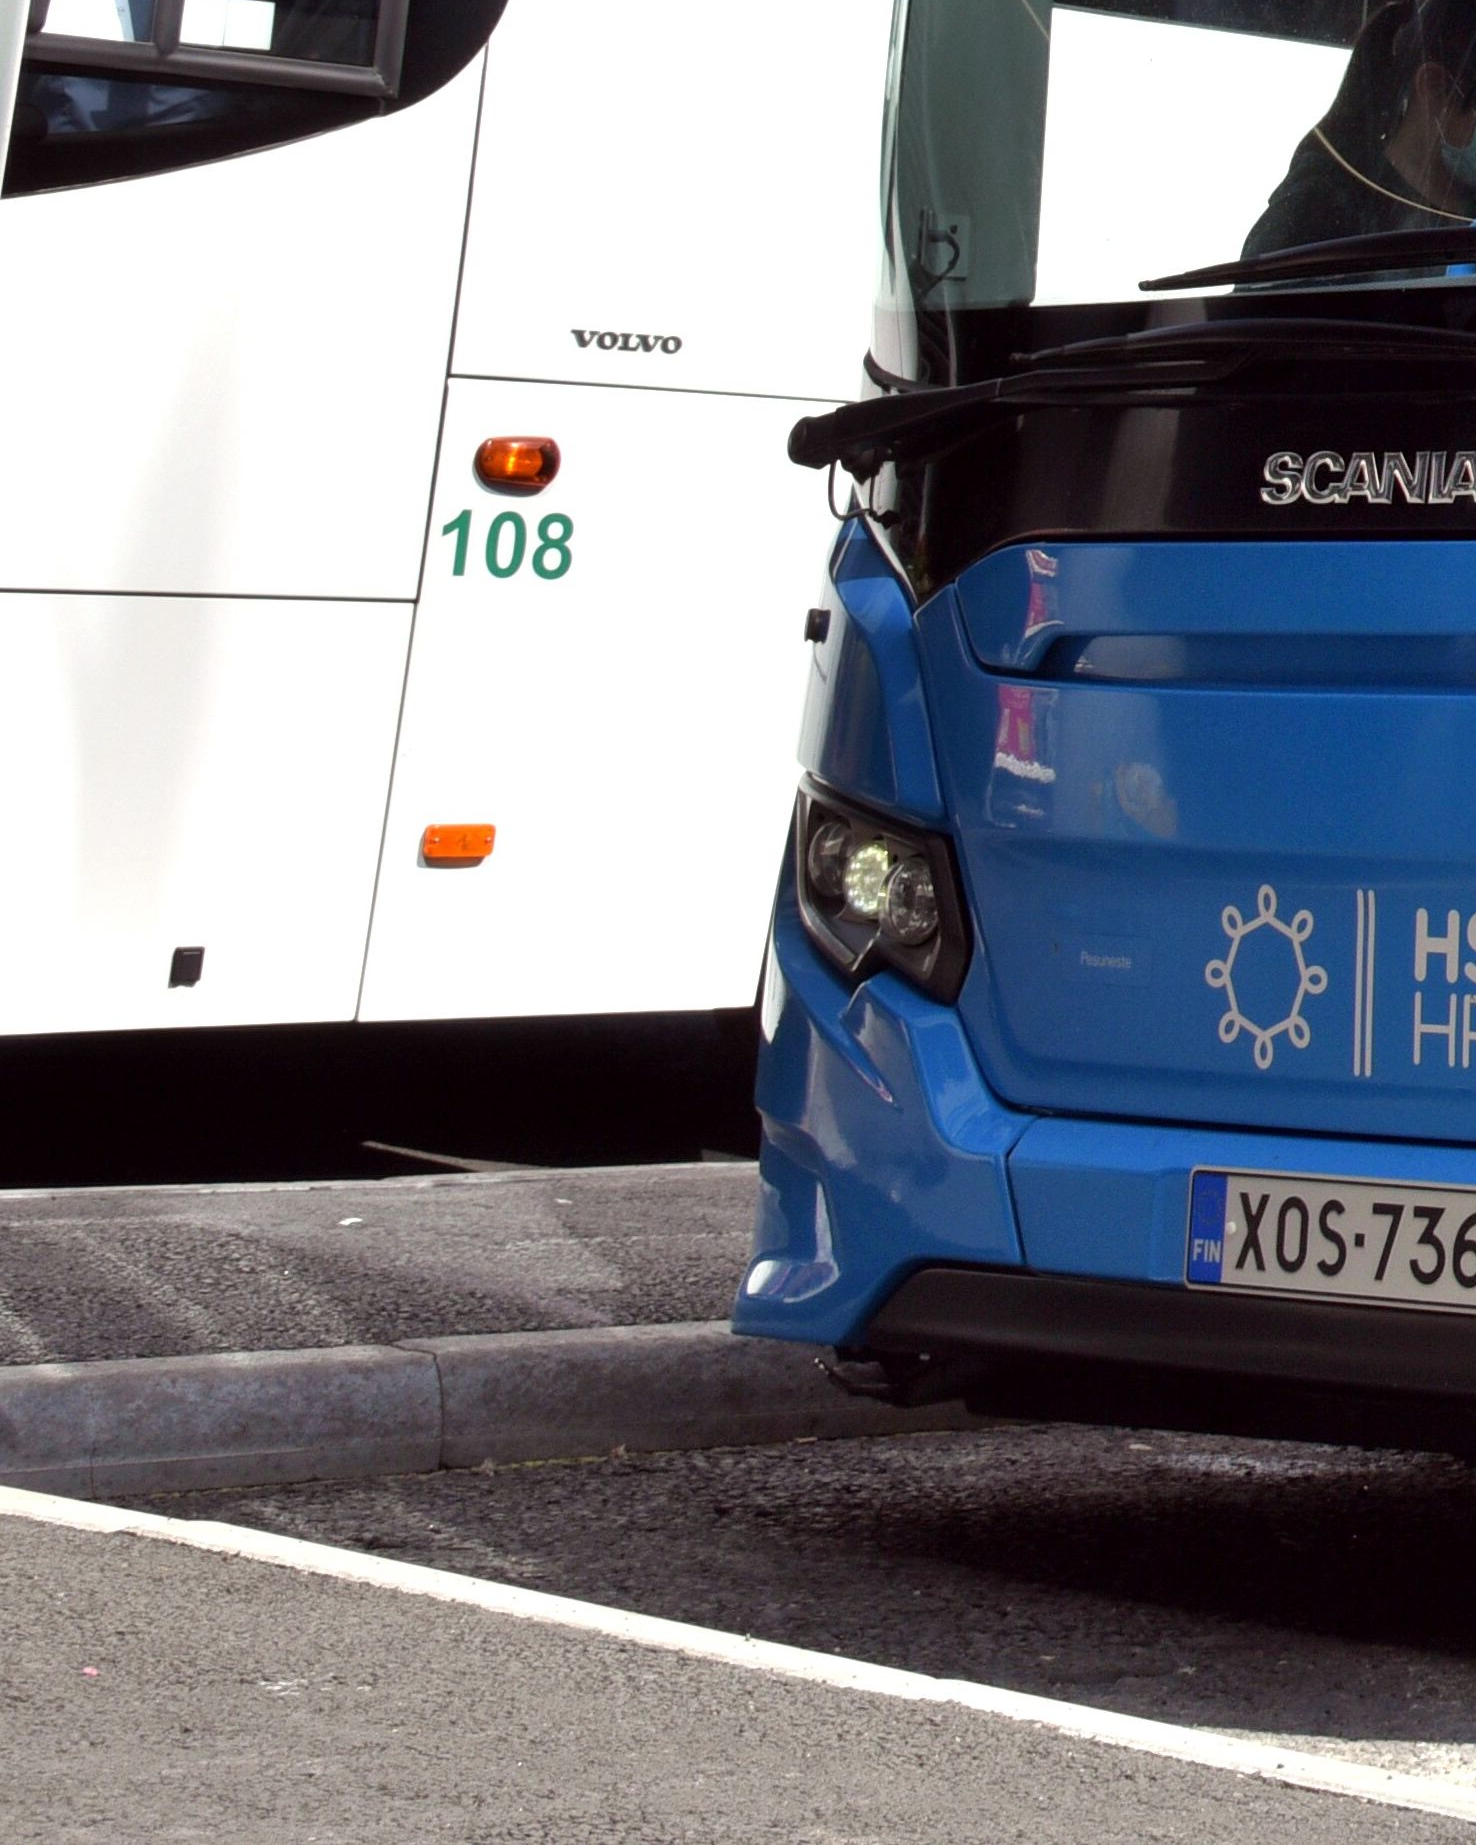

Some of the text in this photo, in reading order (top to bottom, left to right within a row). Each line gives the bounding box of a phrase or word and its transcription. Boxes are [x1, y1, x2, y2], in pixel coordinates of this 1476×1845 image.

[570, 328, 683, 355] VOLVO
[441, 508, 575, 581] 108
[1192, 1238, 1222, 1264] FIN
